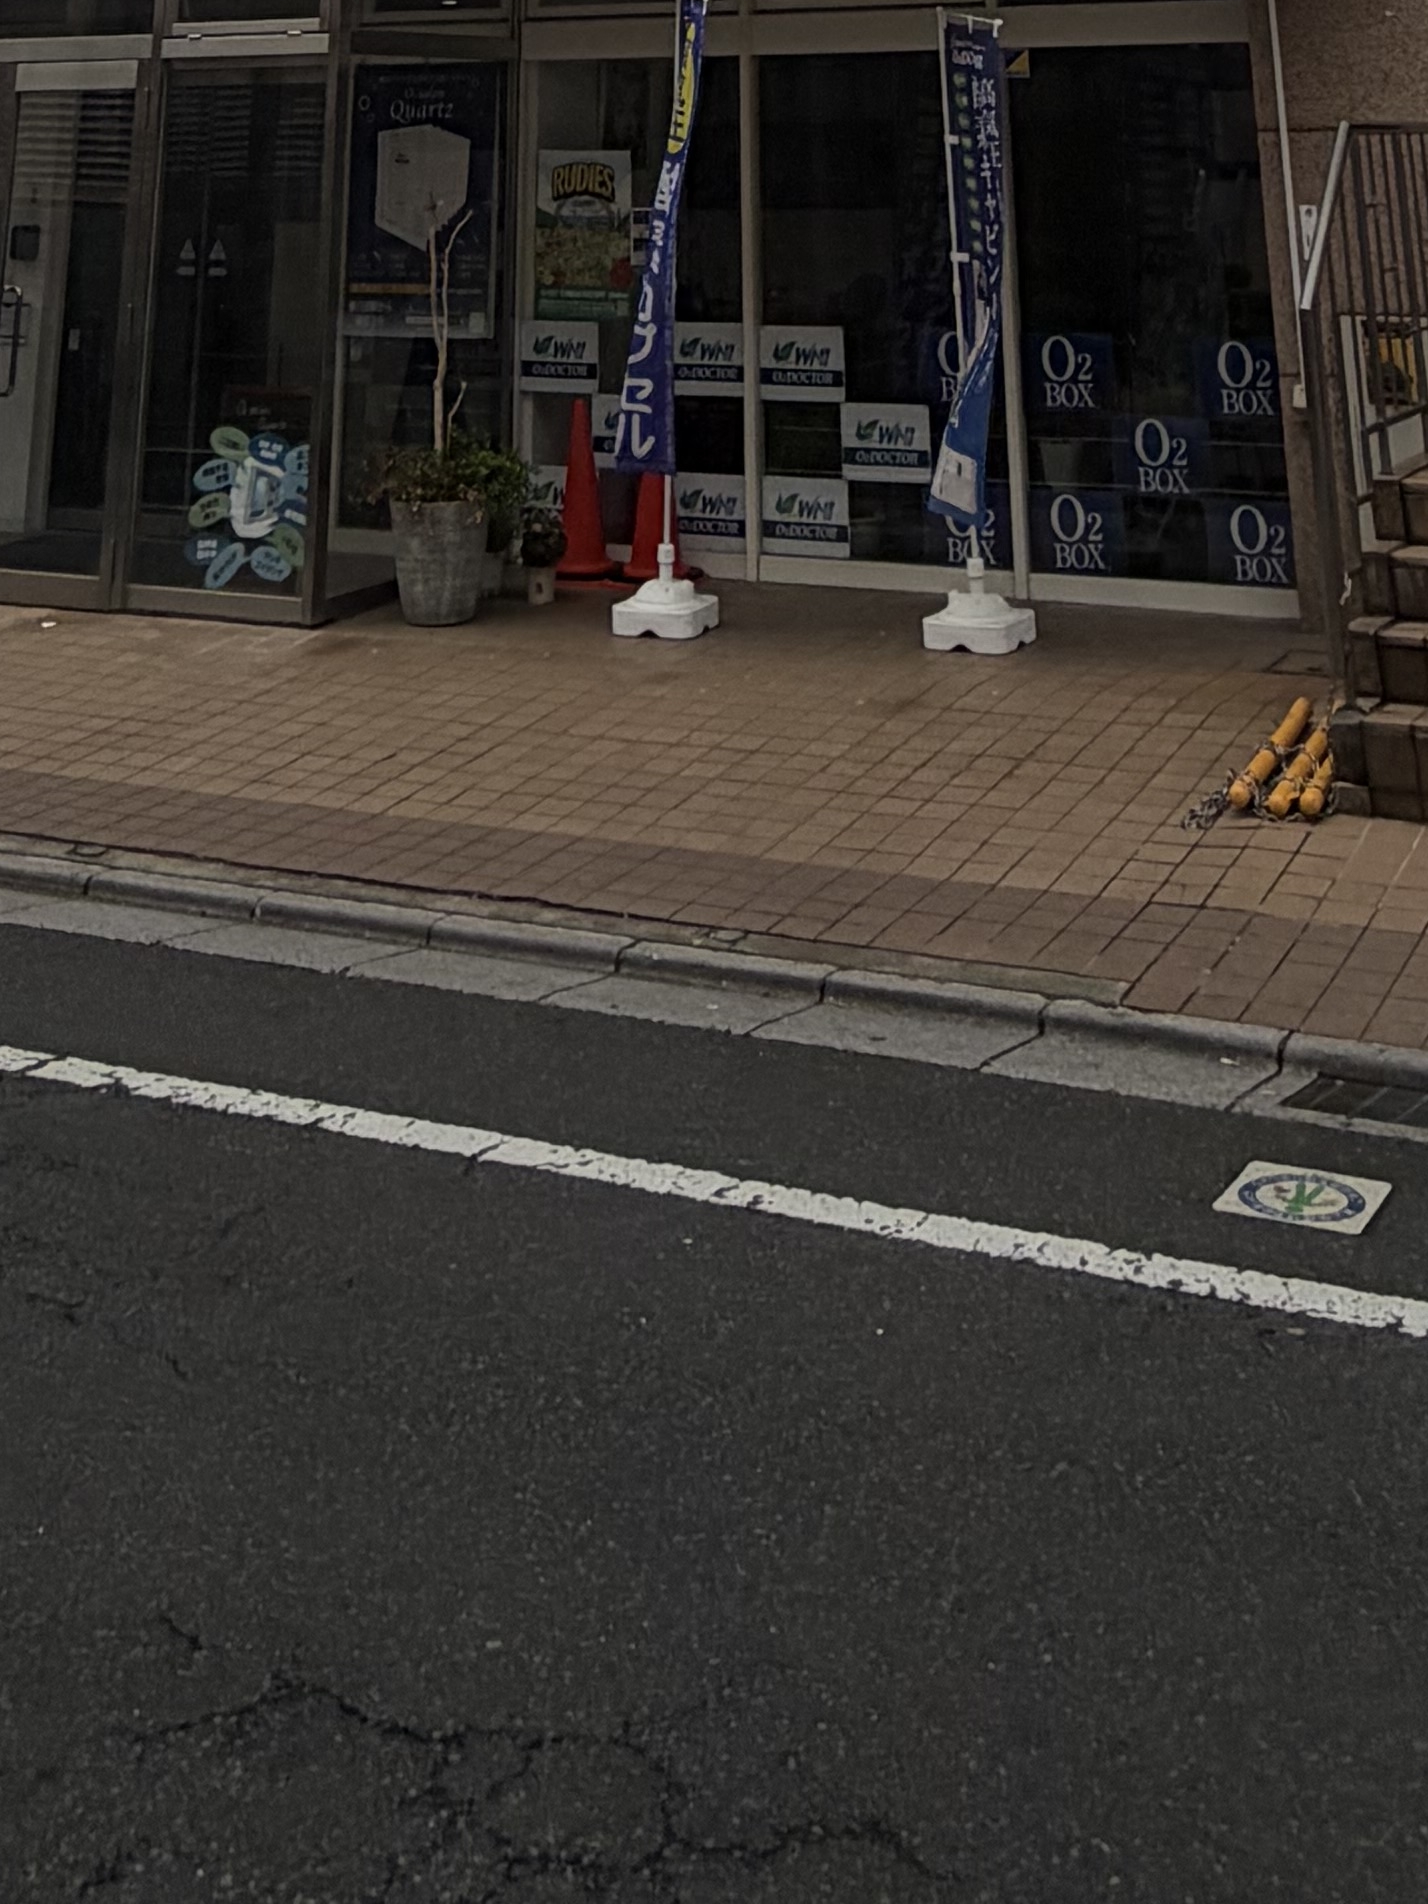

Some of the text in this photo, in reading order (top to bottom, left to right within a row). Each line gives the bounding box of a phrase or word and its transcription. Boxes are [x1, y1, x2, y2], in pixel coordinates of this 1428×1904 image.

[390, 99, 455, 124] Quartz
[552, 163, 615, 201] RUDIES
[1044, 382, 1097, 409] BOX
[1221, 389, 1274, 417] BOX
[1138, 466, 1190, 495] BOX
[1054, 542, 1109, 570] BOX
[1235, 554, 1290, 584] BOX
